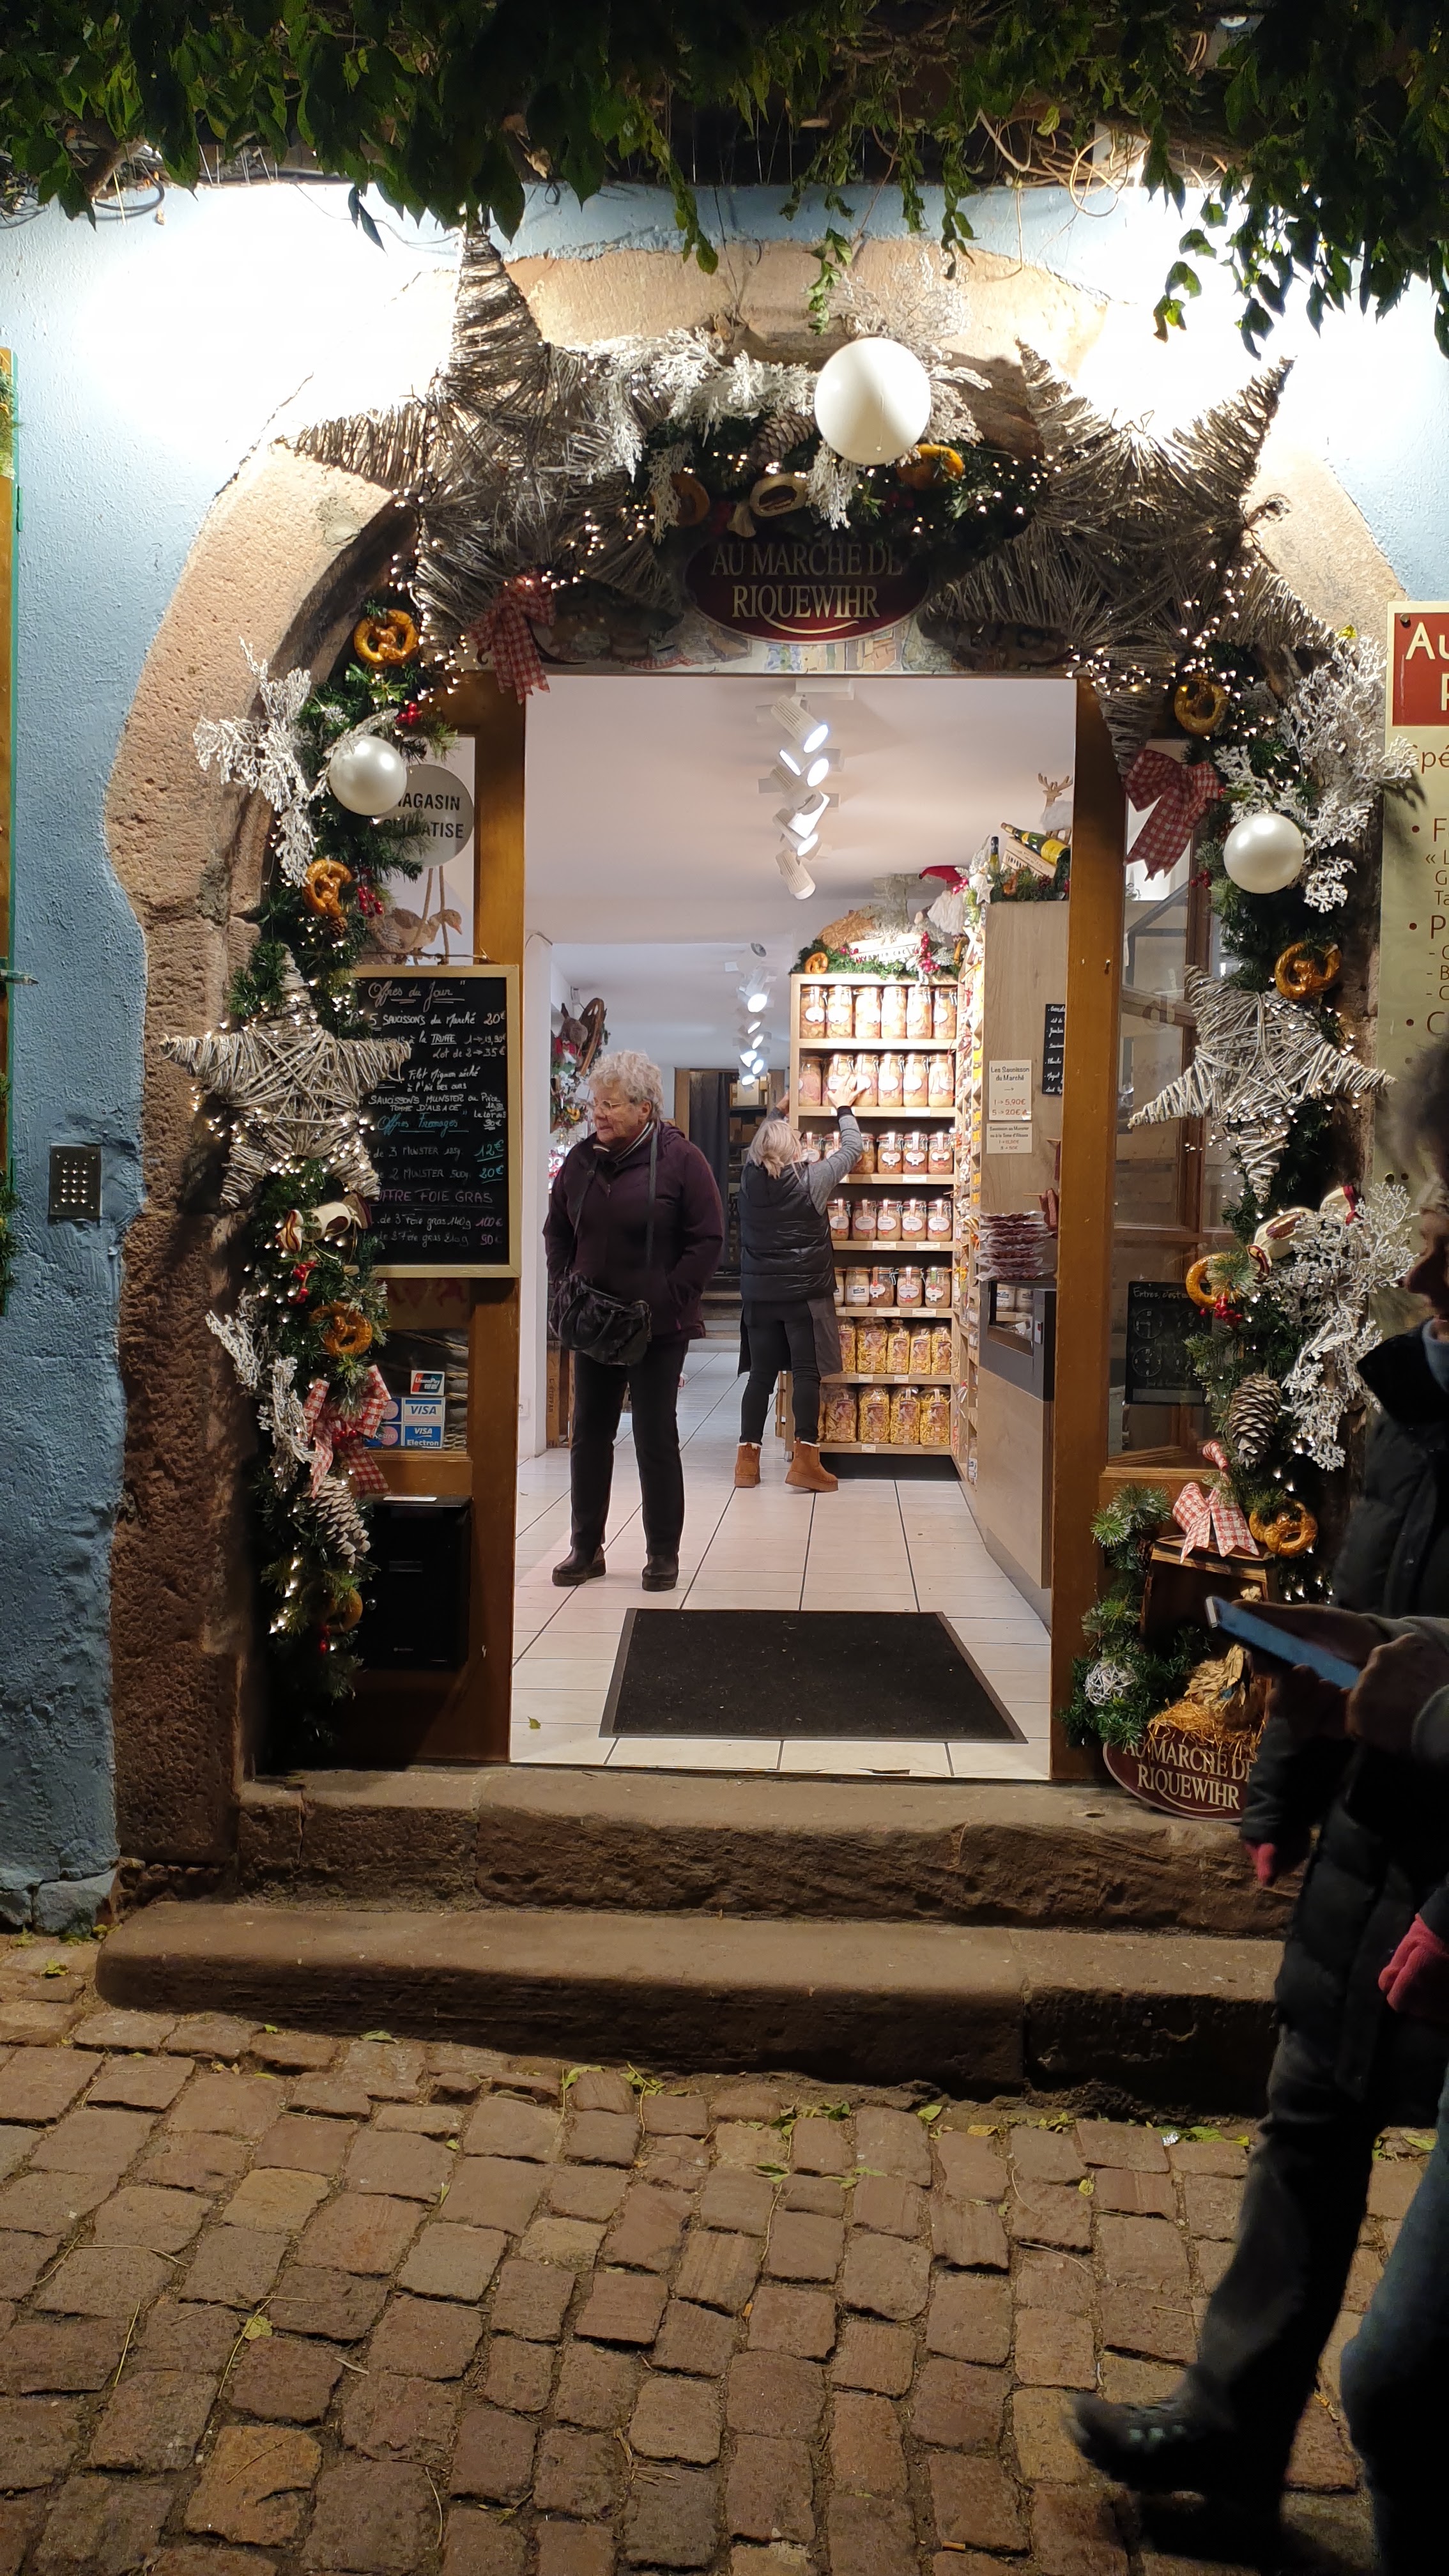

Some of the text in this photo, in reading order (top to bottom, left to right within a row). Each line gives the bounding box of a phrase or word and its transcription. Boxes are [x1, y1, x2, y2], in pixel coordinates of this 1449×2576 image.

[711, 544, 744, 575] AU
[751, 543, 862, 575] MARCHE
[732, 585, 880, 634] RIQUEWIHR
[368, 980, 453, 1013] Offres du Jour
[369, 1013, 378, 1027] 5
[430, 1013, 442, 1025] du
[446, 1011, 477, 1028] Marché
[409, 1034, 416, 1045] à
[418, 1029, 427, 1043] la
[452, 1048, 463, 1059] de
[408, 1067, 428, 1080] Filet
[407, 1083, 413, 1092] à
[425, 1094, 464, 1104] MUNSTER
[402, 1146, 439, 1156] MUNSTER
[473, 1139, 504, 1158] 12€
[389, 1168, 399, 1181] 2
[403, 1169, 445, 1180] MUNSTER
[479, 1165, 504, 1179] 20€
[455, 1191, 494, 1203] GRAS
[395, 1214, 402, 1225] 3
[411, 1406, 437, 1415] VISA
[1137, 1763, 1241, 1813] RIQUEWIHR
